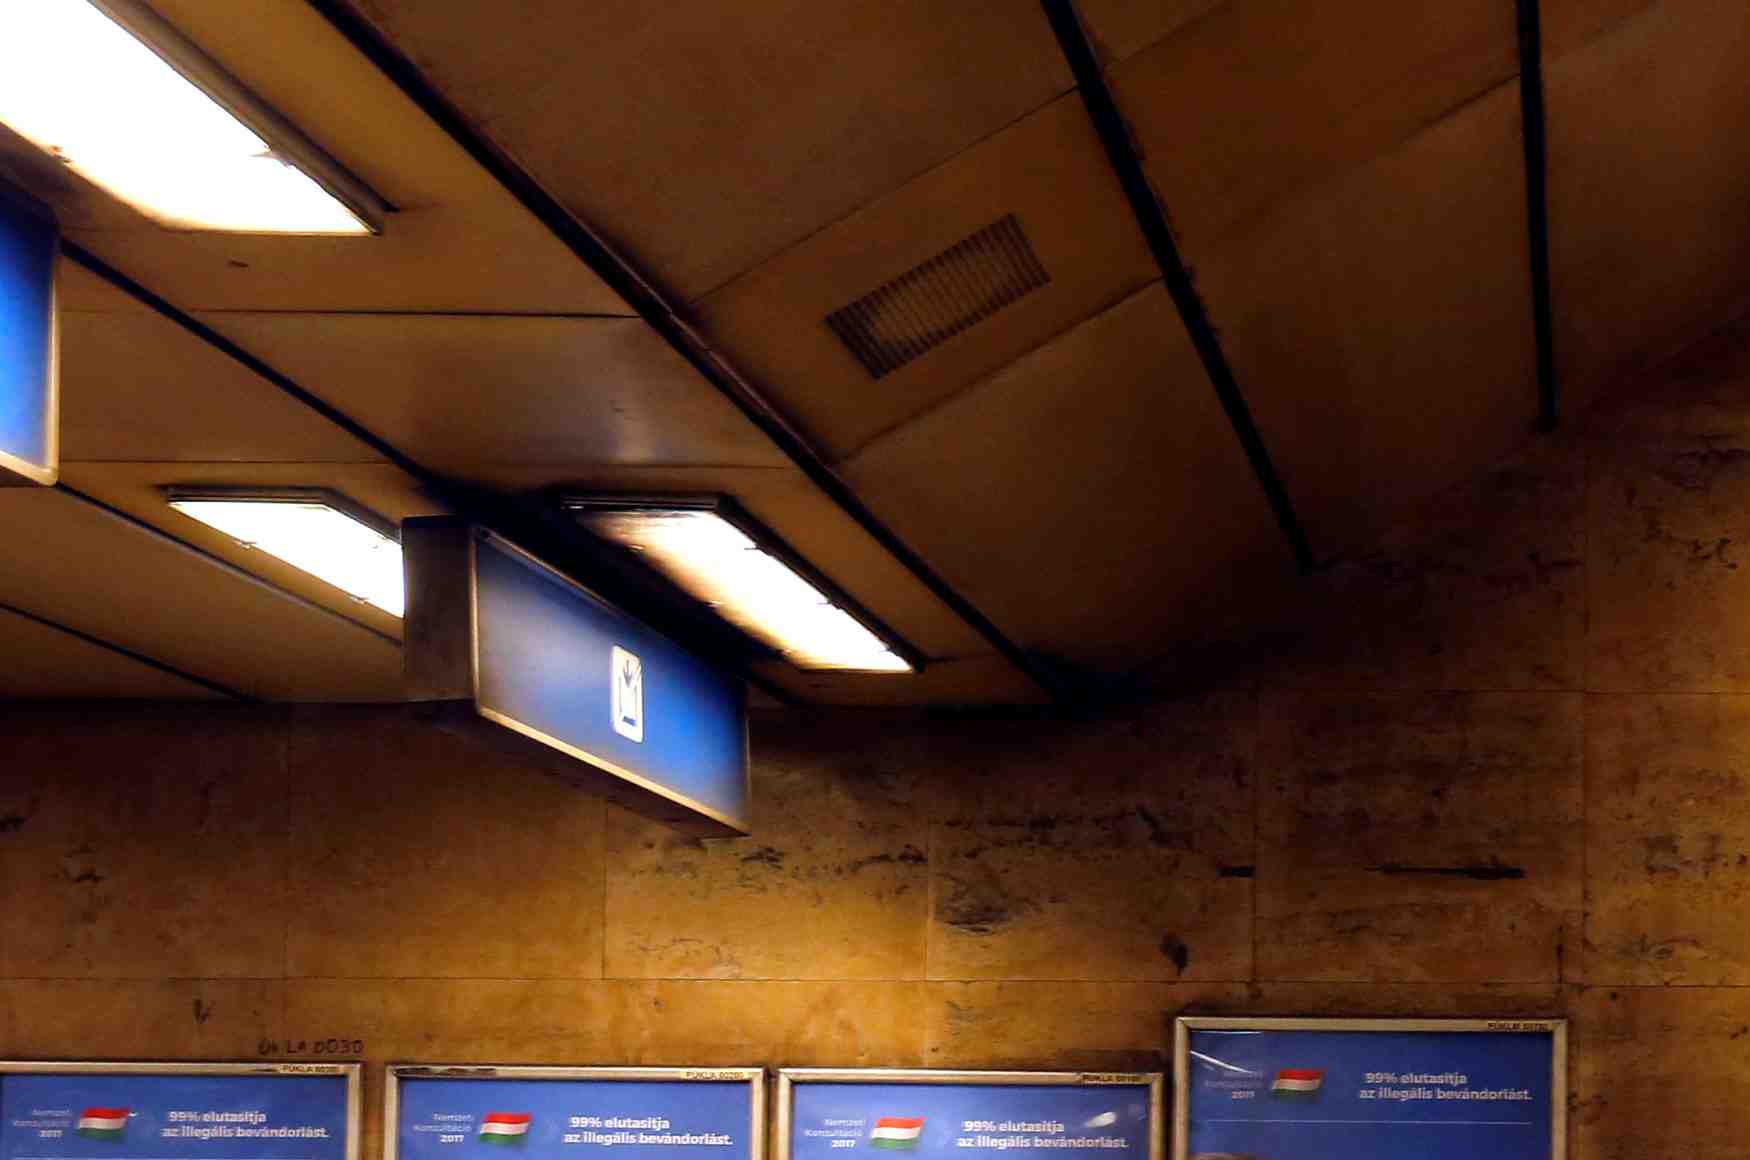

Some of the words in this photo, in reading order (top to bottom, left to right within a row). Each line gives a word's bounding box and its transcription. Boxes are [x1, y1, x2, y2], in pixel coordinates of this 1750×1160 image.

[1365, 1072, 1397, 1083] 99%
[1360, 1090, 1374, 1099] az
[168, 1111, 199, 1122] 99%
[570, 1117, 601, 1128] 99%
[964, 1121, 996, 1131] 99%
[162, 1128, 178, 1137] az
[440, 1135, 464, 1143] 2017
[564, 1134, 580, 1144] az
[957, 1138, 973, 1147] az
